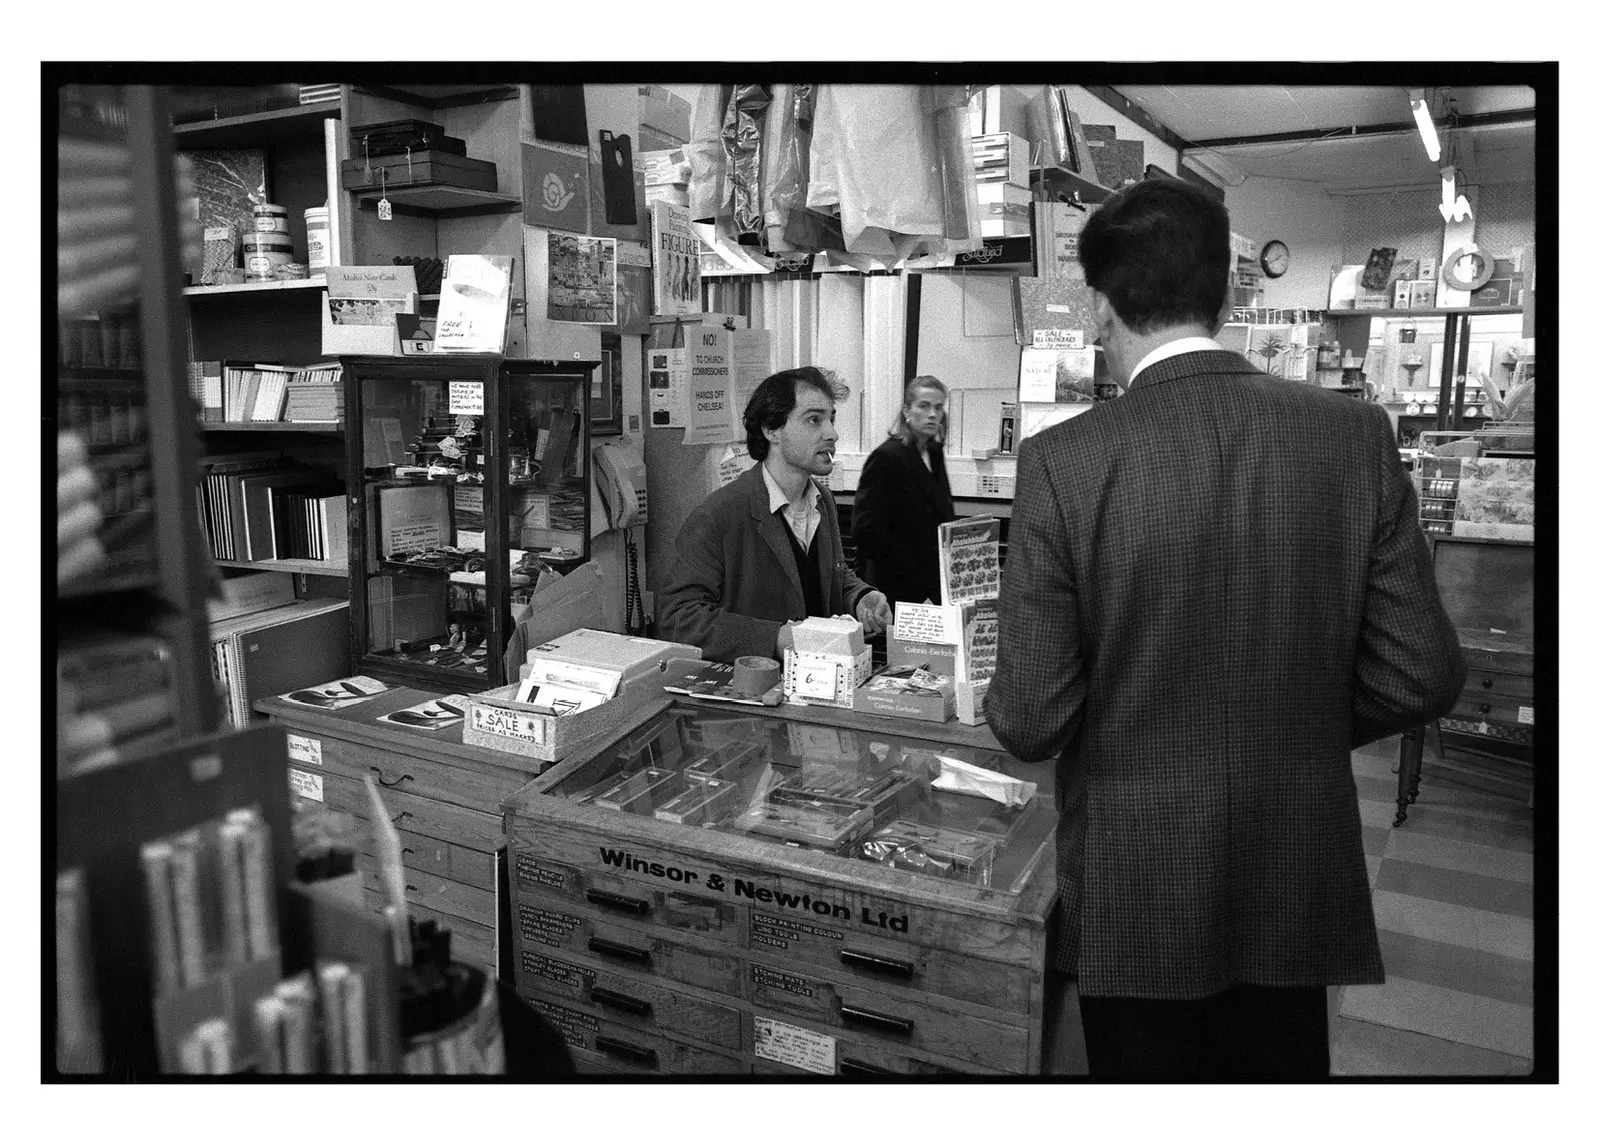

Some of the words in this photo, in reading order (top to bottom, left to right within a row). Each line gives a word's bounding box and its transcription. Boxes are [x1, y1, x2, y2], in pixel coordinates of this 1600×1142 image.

[661, 232, 700, 256] FIGURE
[702, 333, 718, 346] NO!
[703, 355, 725, 364] CHURCH
[692, 367, 729, 376] COMMISSIONERS
[696, 390, 714, 399] HANDS
[714, 390, 725, 399] OFF
[697, 402, 724, 411] CHELSEA!
[494, 709, 517, 719] CARDS
[486, 714, 519, 732] SALE
[600, 847, 698, 884] Winsor
[705, 873, 726, 892] &
[734, 878, 851, 920] Newton
[862, 907, 908, 933] Ltd
[754, 914, 777, 925] BLOCK
[778, 919, 812, 934] PRNTING
[813, 927, 843, 940] COLOUR
[753, 934, 787, 948] HOLDERS
[775, 929, 798, 940] TOOLS
[754, 967, 784, 980] ETCHING
[754, 976, 786, 989] ETCHING
[787, 983, 811, 996] TOOLS
